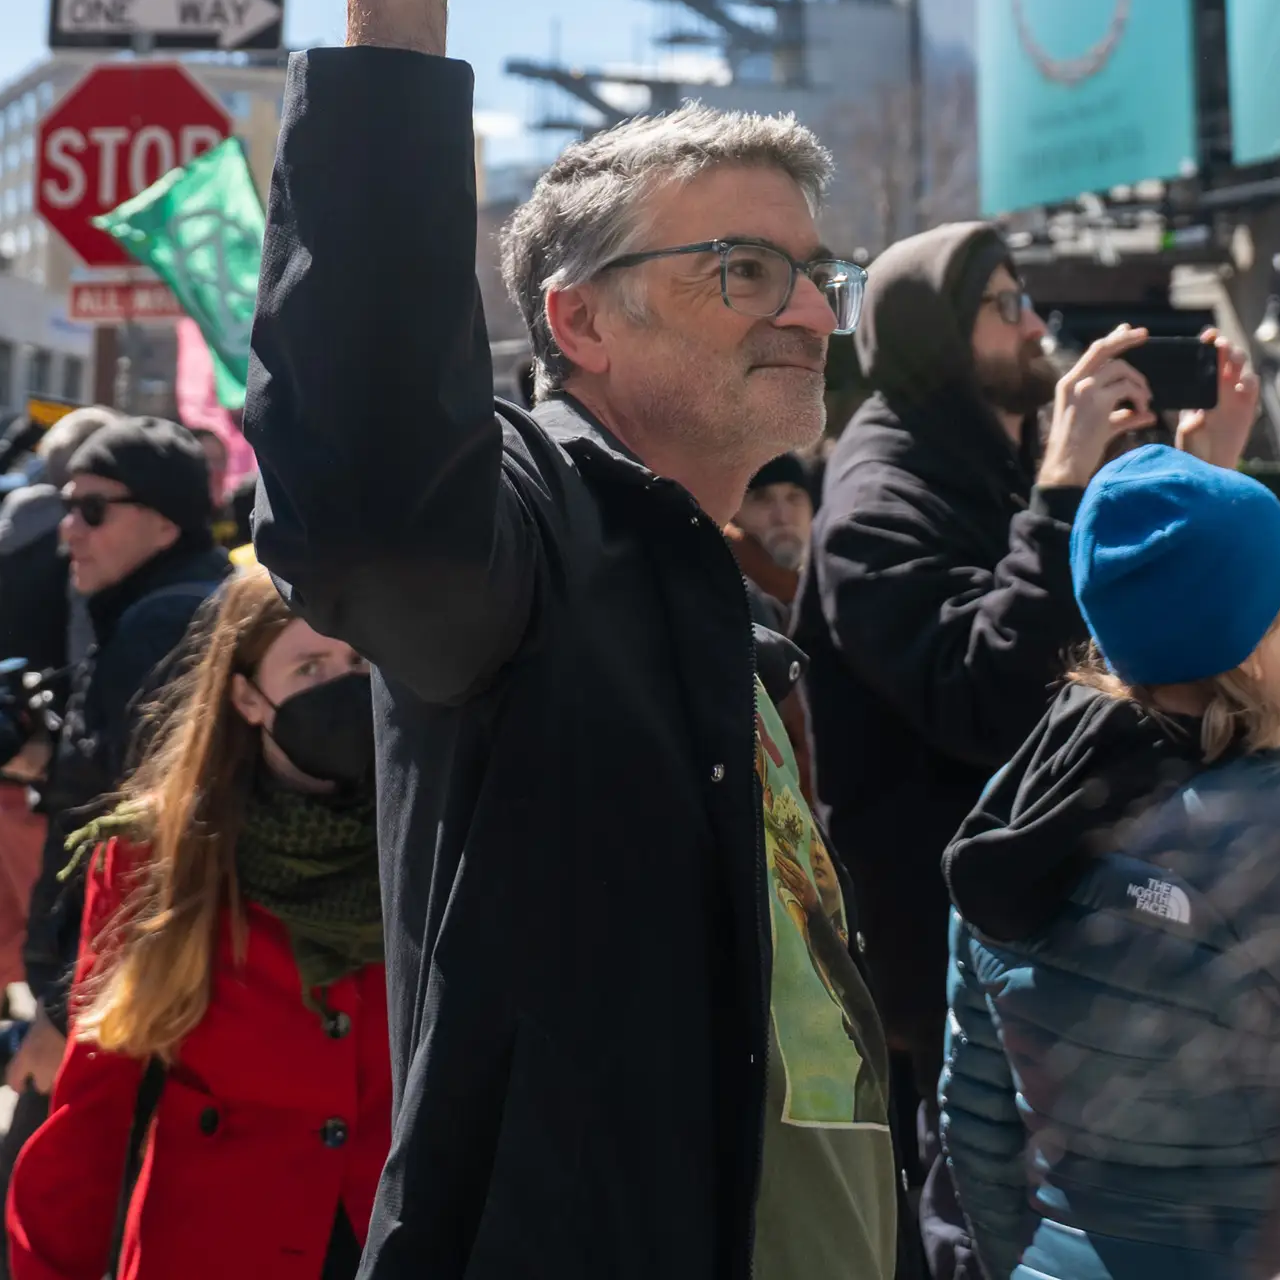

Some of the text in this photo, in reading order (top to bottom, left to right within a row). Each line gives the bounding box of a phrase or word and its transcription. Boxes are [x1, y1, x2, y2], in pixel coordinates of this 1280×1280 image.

[77, 286, 119, 313] ALL
[1126, 882, 1172, 907] NORTH
[1148, 877, 1172, 895] THE
[1135, 896, 1168, 918] FACE
